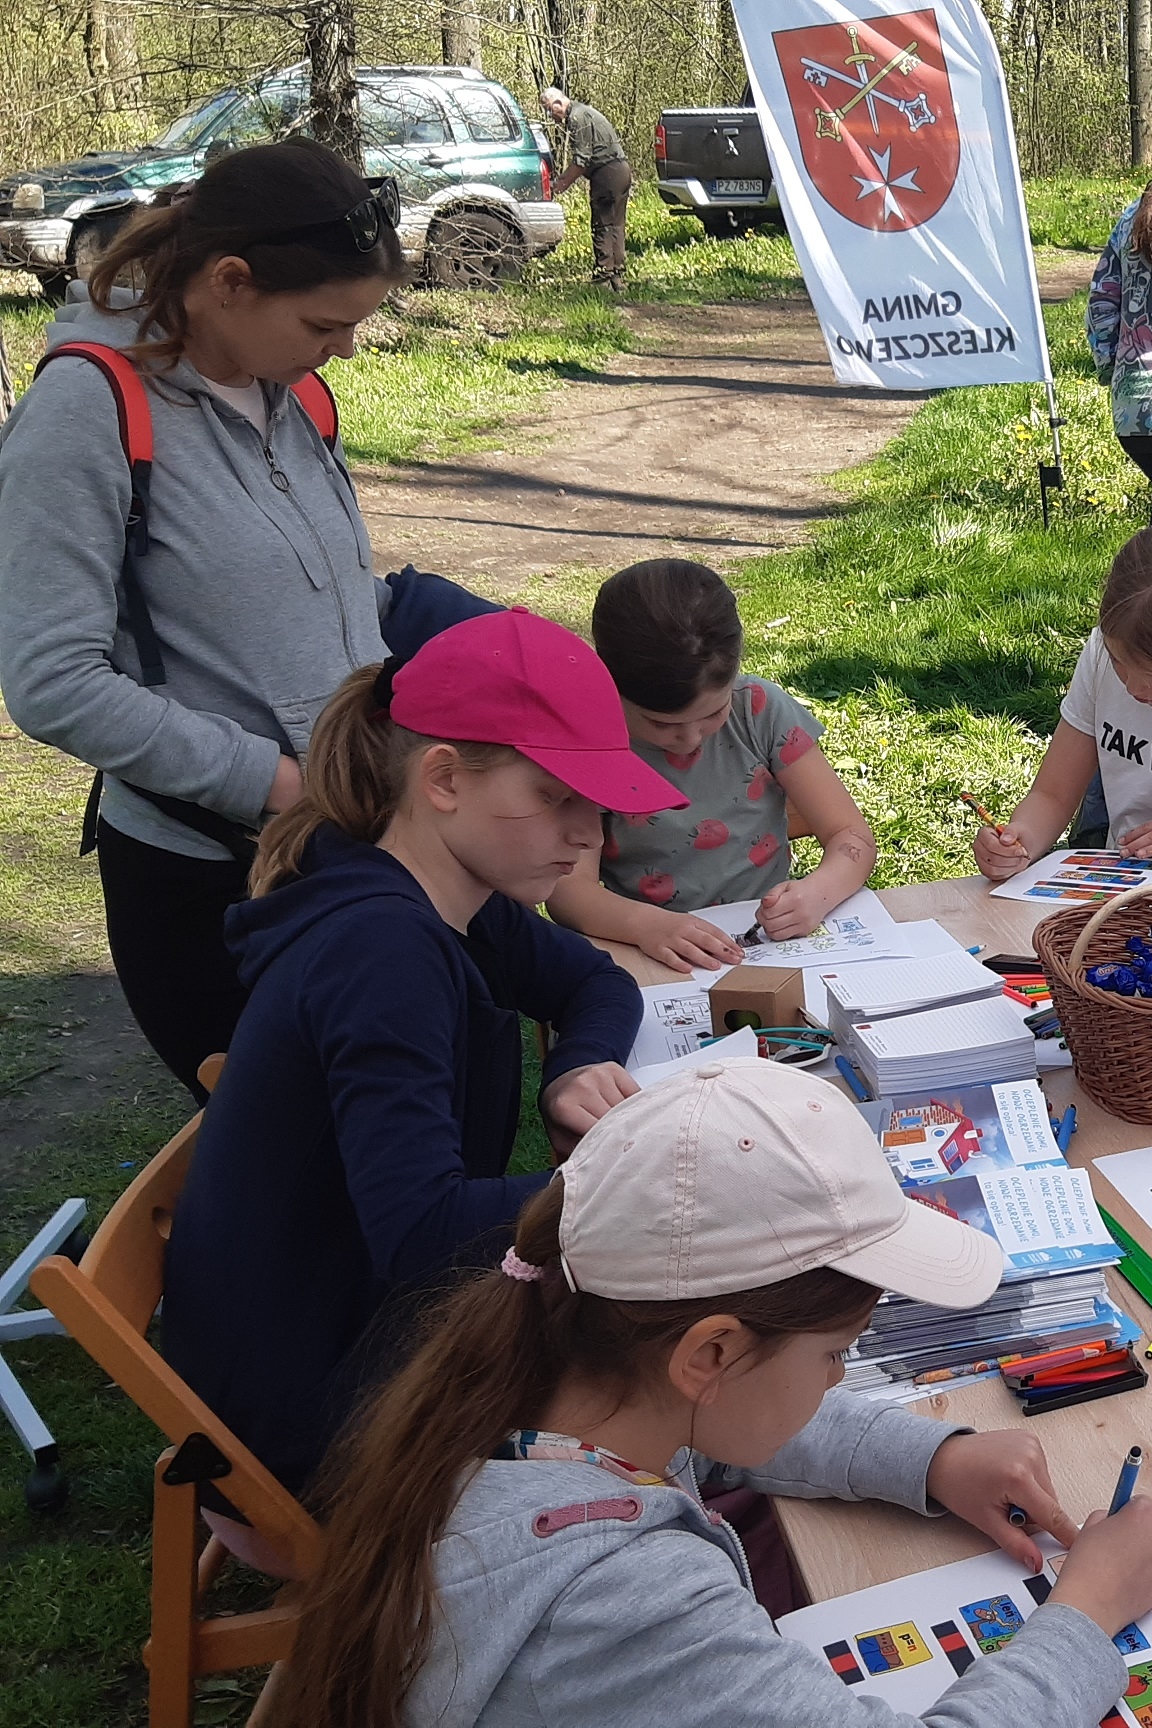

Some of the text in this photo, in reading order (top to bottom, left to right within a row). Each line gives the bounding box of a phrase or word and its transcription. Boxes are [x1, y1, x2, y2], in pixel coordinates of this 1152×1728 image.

[718, 180, 762, 192] PZ 783NS
[1100, 721, 1149, 766] TAK
[1001, 1101, 1009, 1113] się
[1011, 1090, 1024, 1111] NOWE
[1023, 1088, 1041, 1131] OCIEPLENIE
[986, 1190, 995, 1201] się
[998, 1179, 1012, 1200] NOWE
[1010, 1176, 1032, 1218] OCIEPLENIE
[1038, 1177, 1052, 1198] NOWE
[1051, 1175, 1071, 1215] OCIEPLENIE
